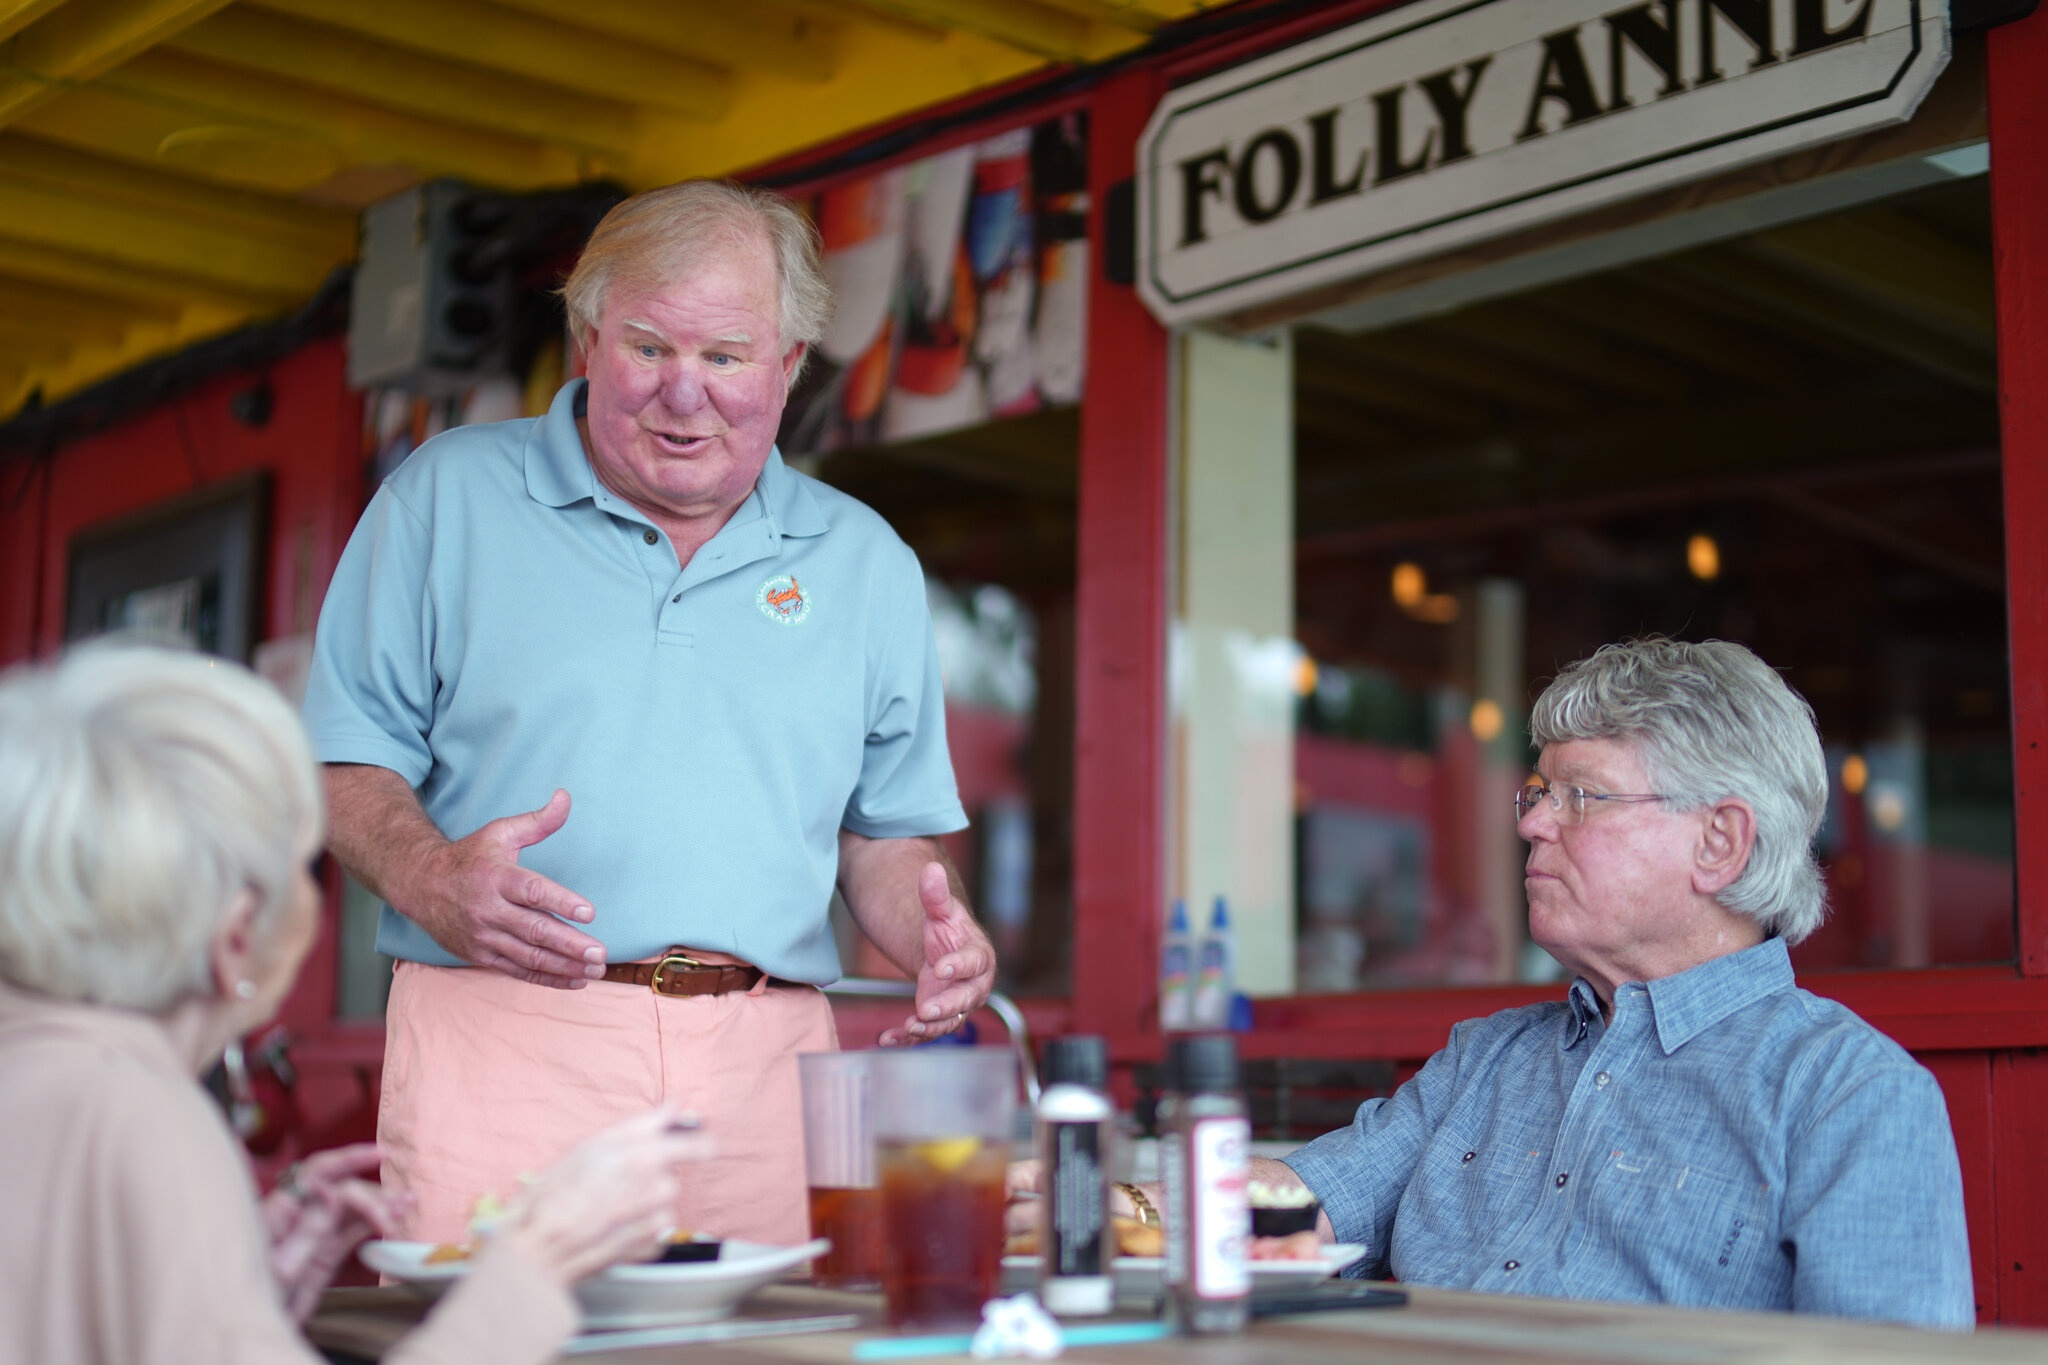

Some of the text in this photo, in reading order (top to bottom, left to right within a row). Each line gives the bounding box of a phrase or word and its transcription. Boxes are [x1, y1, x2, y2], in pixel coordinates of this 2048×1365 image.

[1178, 54, 1495, 249] FOLLY
[760, 604, 791, 624] CRAB
[1718, 1218, 1745, 1268] ORVIS
